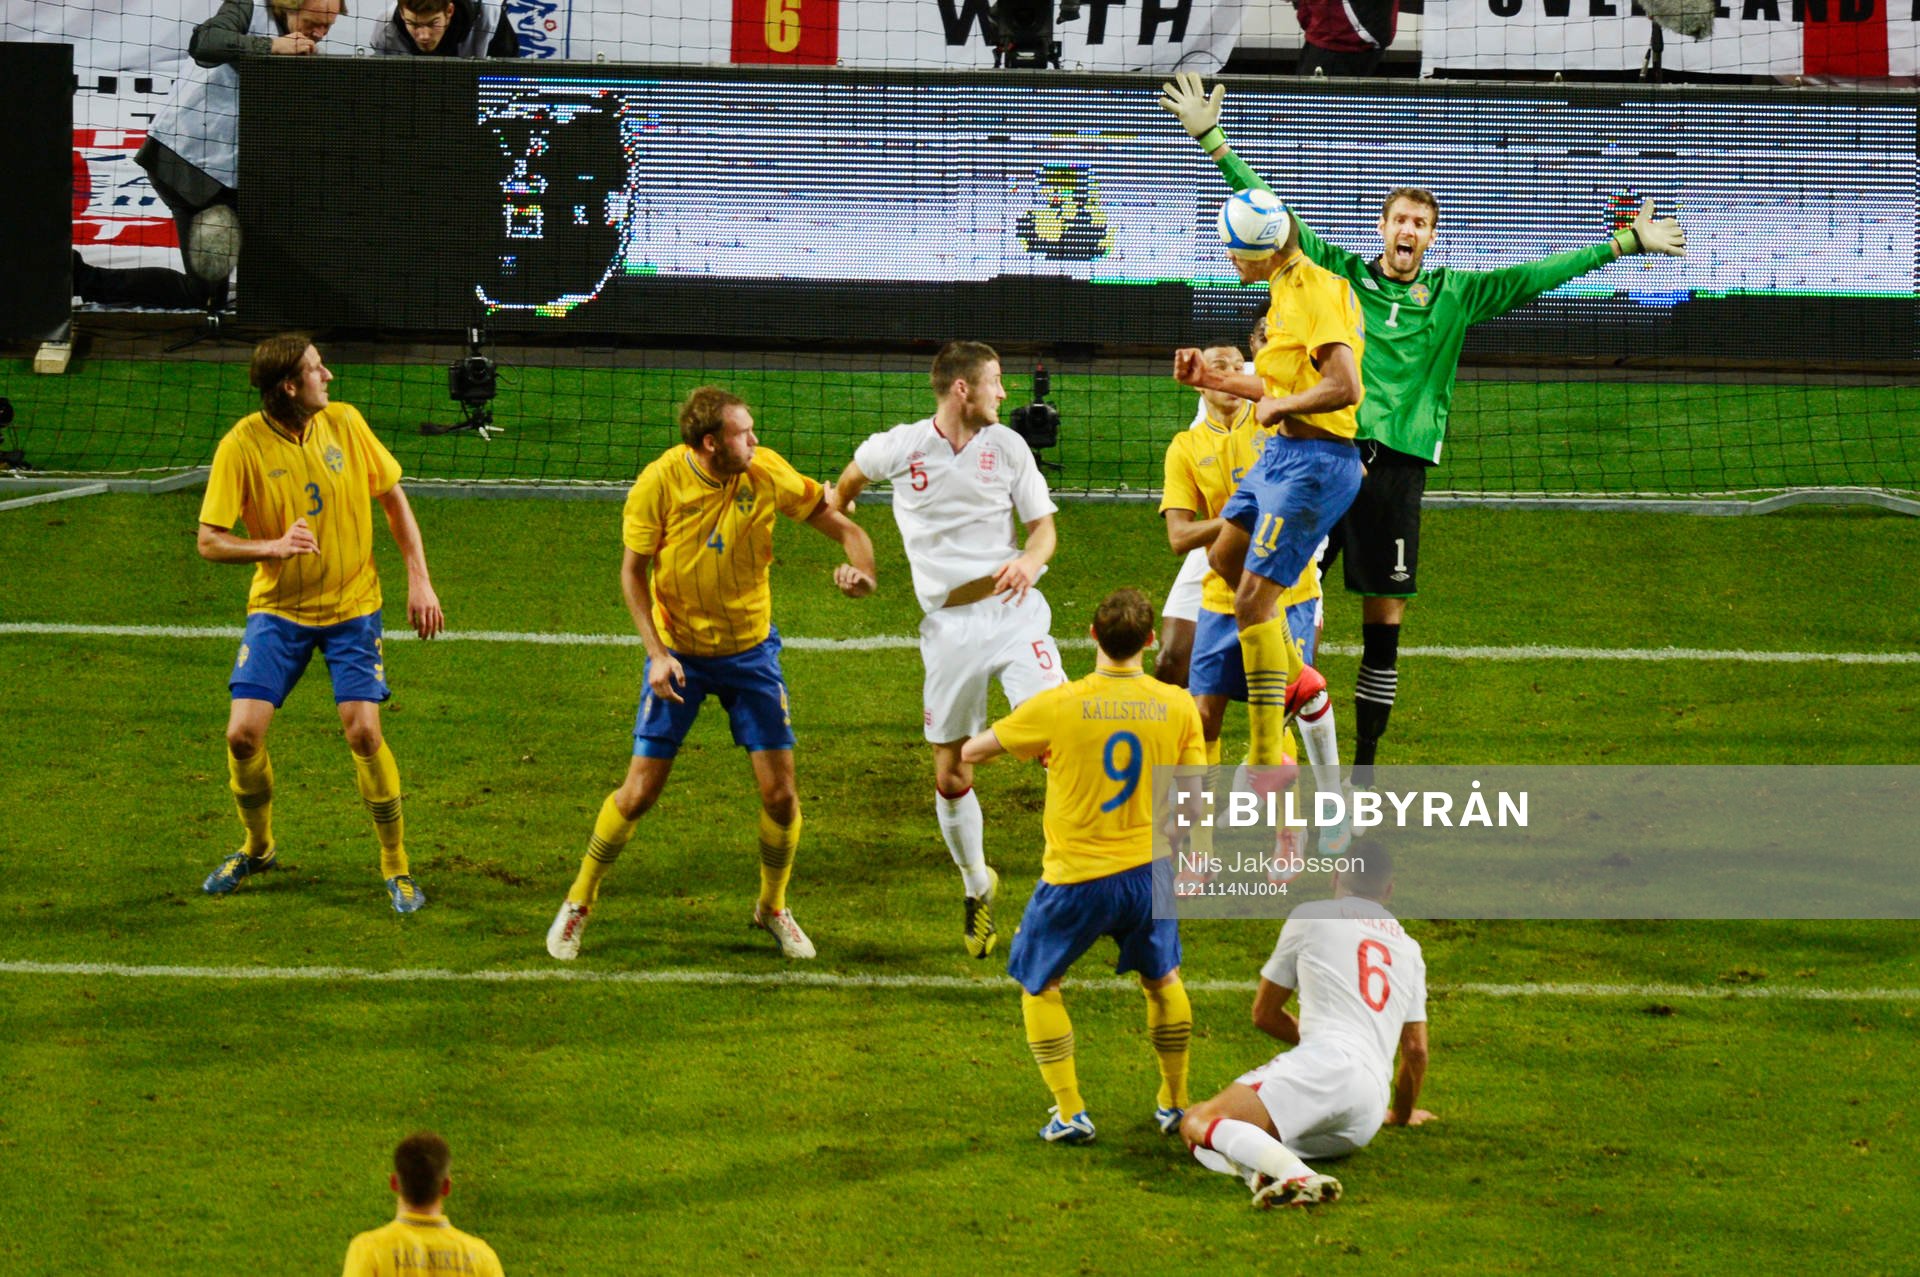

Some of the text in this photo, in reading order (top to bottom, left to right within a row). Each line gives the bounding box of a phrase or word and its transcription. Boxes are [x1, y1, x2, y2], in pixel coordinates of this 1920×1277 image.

[765, 0, 801, 53] 6
[937, 0, 1193, 46] WTH
[1385, 302, 1399, 328] 1
[909, 461, 929, 492] 5
[304, 482, 324, 516] 3
[707, 527, 725, 555] 4
[1254, 512, 1285, 552] 11
[1394, 538, 1407, 571] 1
[1031, 639, 1054, 671] 5
[1081, 697, 1168, 722] KÄLLSTRÖM
[1100, 730, 1144, 813] 9
[1357, 938, 1393, 1013] 6
